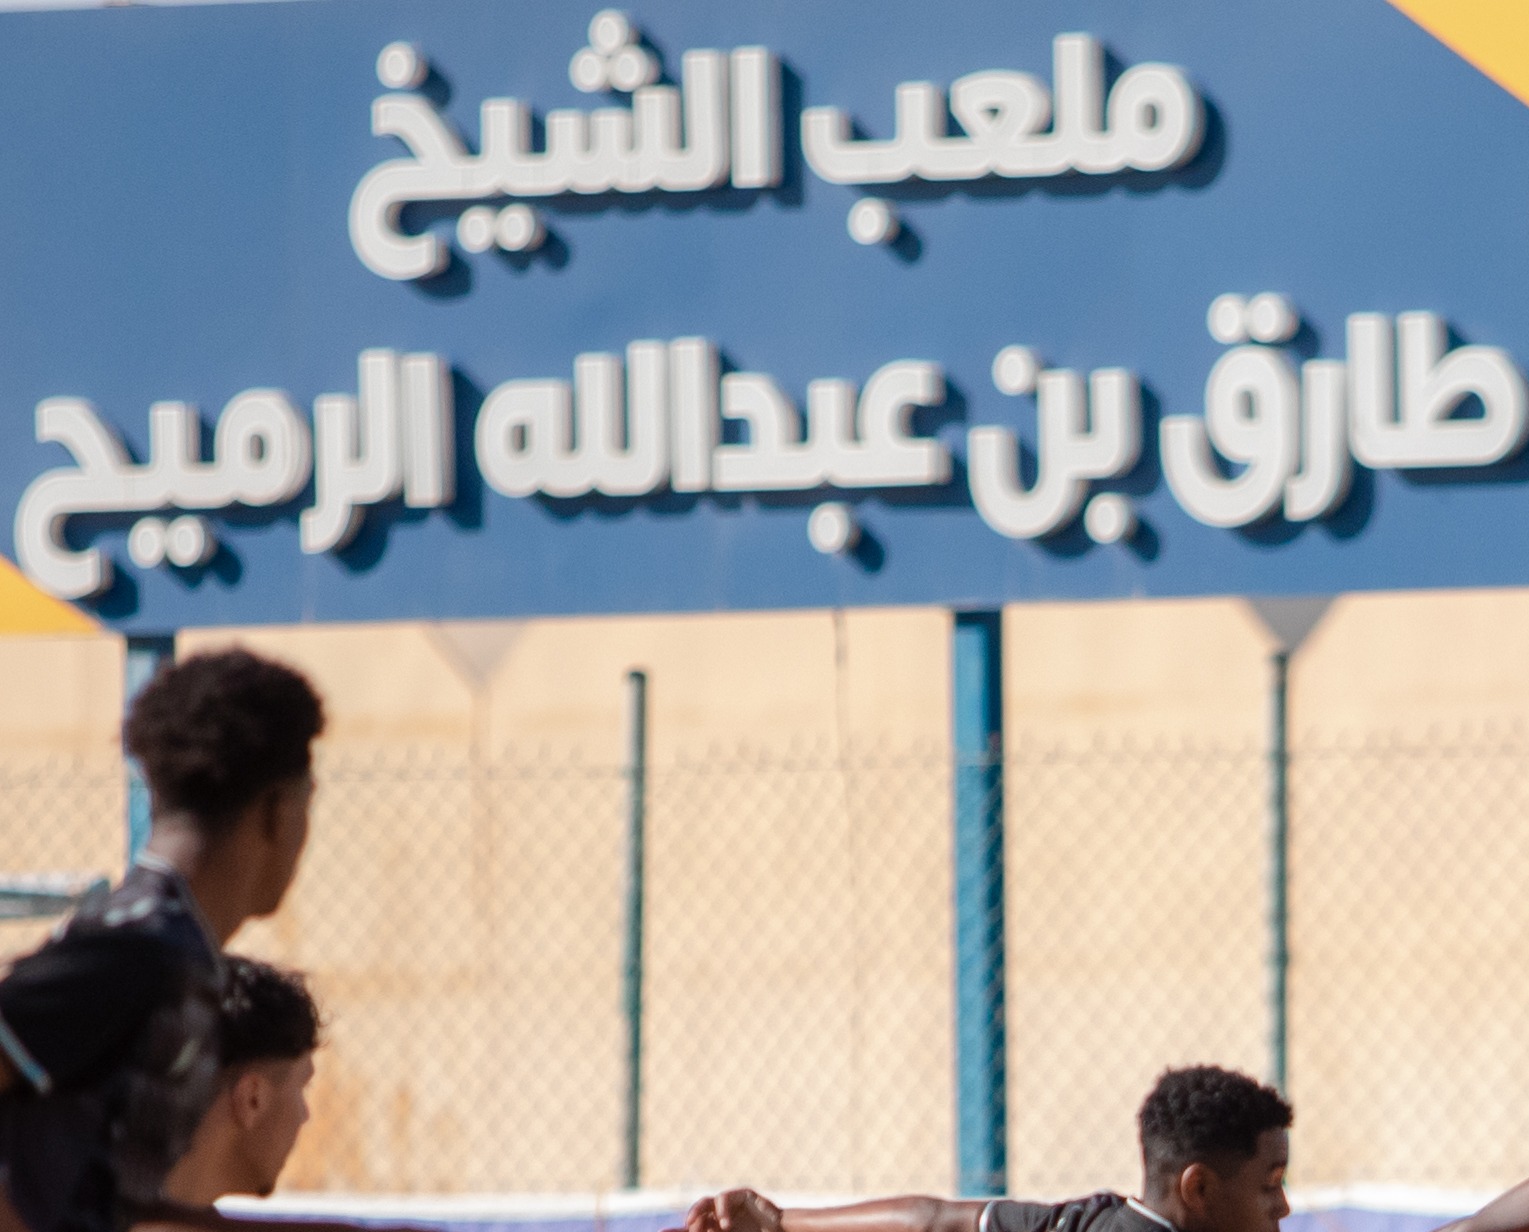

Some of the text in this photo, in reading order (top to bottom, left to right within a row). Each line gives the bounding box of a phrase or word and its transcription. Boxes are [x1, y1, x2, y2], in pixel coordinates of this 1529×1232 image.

[350, 9, 1207, 281] ملعب الشيخ
[14, 348, 457, 600] الرميح
[474, 336, 955, 555] عبدالله
[968, 344, 1147, 545] بن
